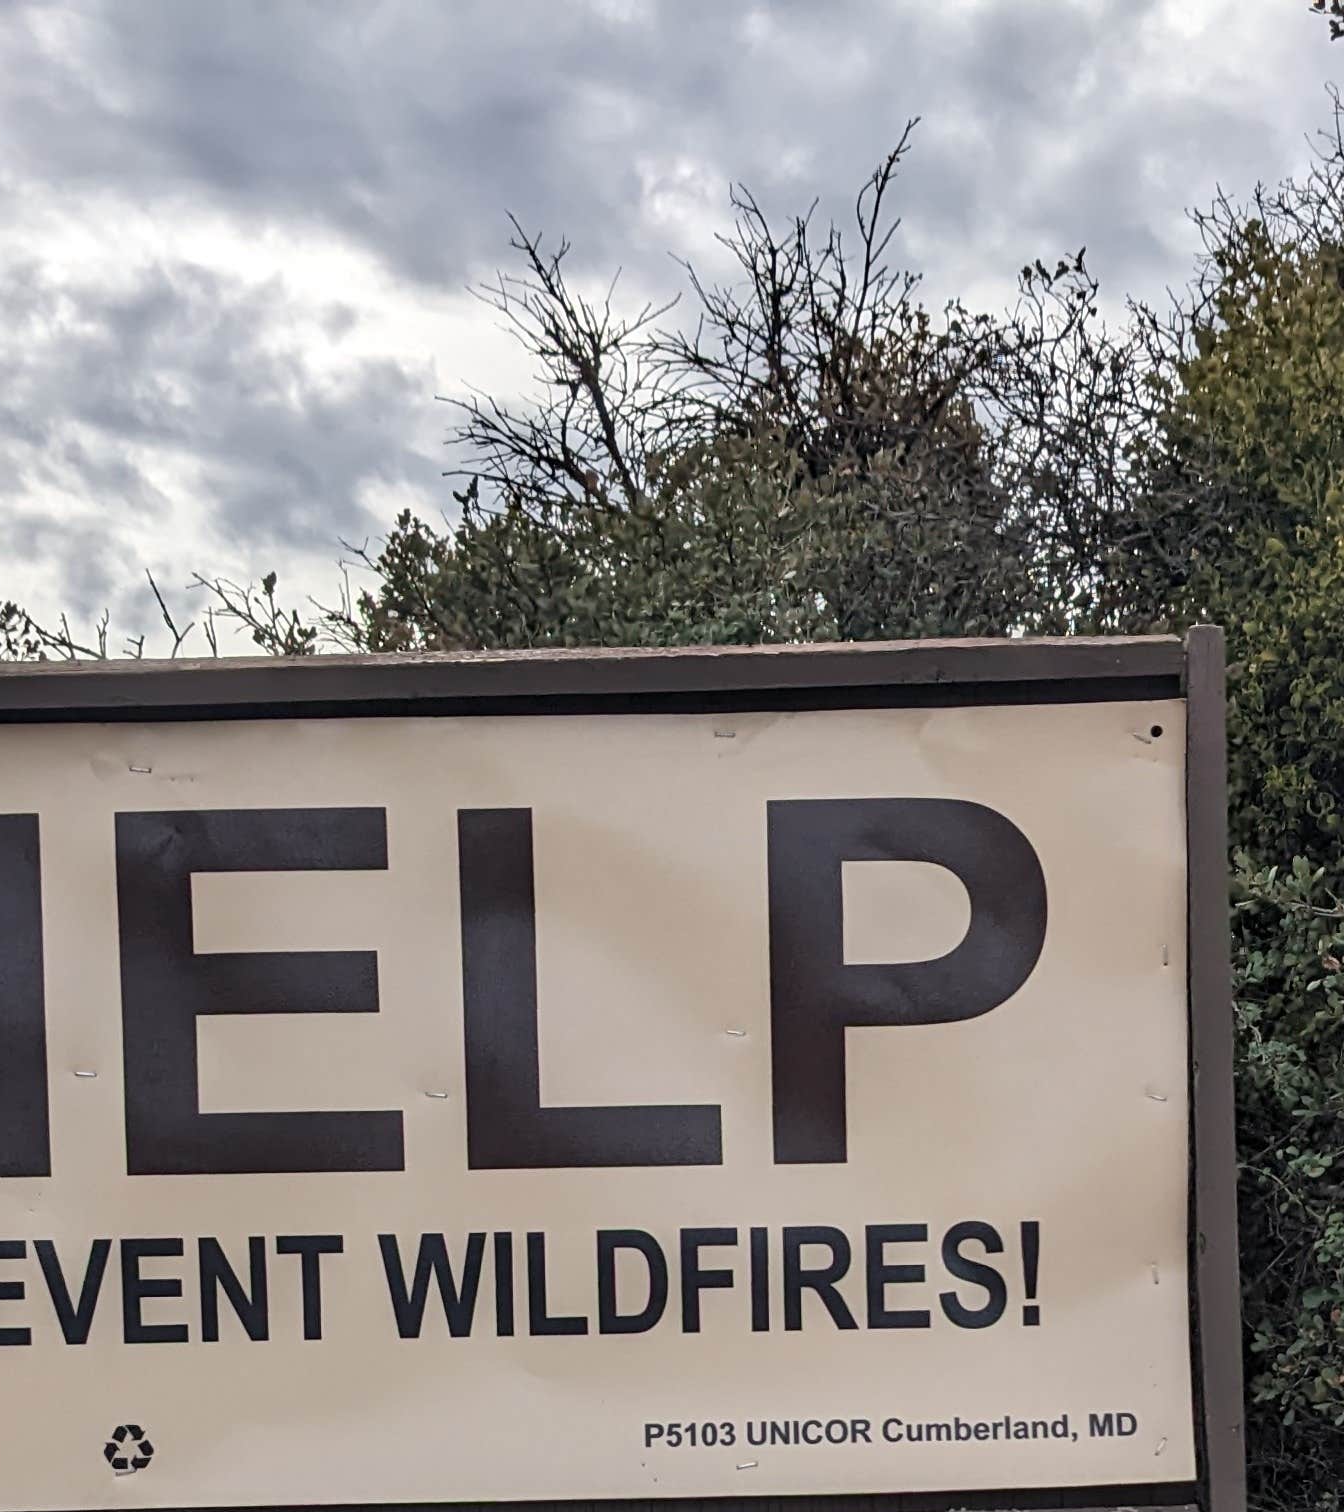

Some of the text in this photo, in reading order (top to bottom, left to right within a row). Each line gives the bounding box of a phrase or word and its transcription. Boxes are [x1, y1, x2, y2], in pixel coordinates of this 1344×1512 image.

[378, 1221, 1040, 1338] WILDFIRES!
[645, 1413, 1137, 1447] P5103 UNICOR Cumberland, MD
